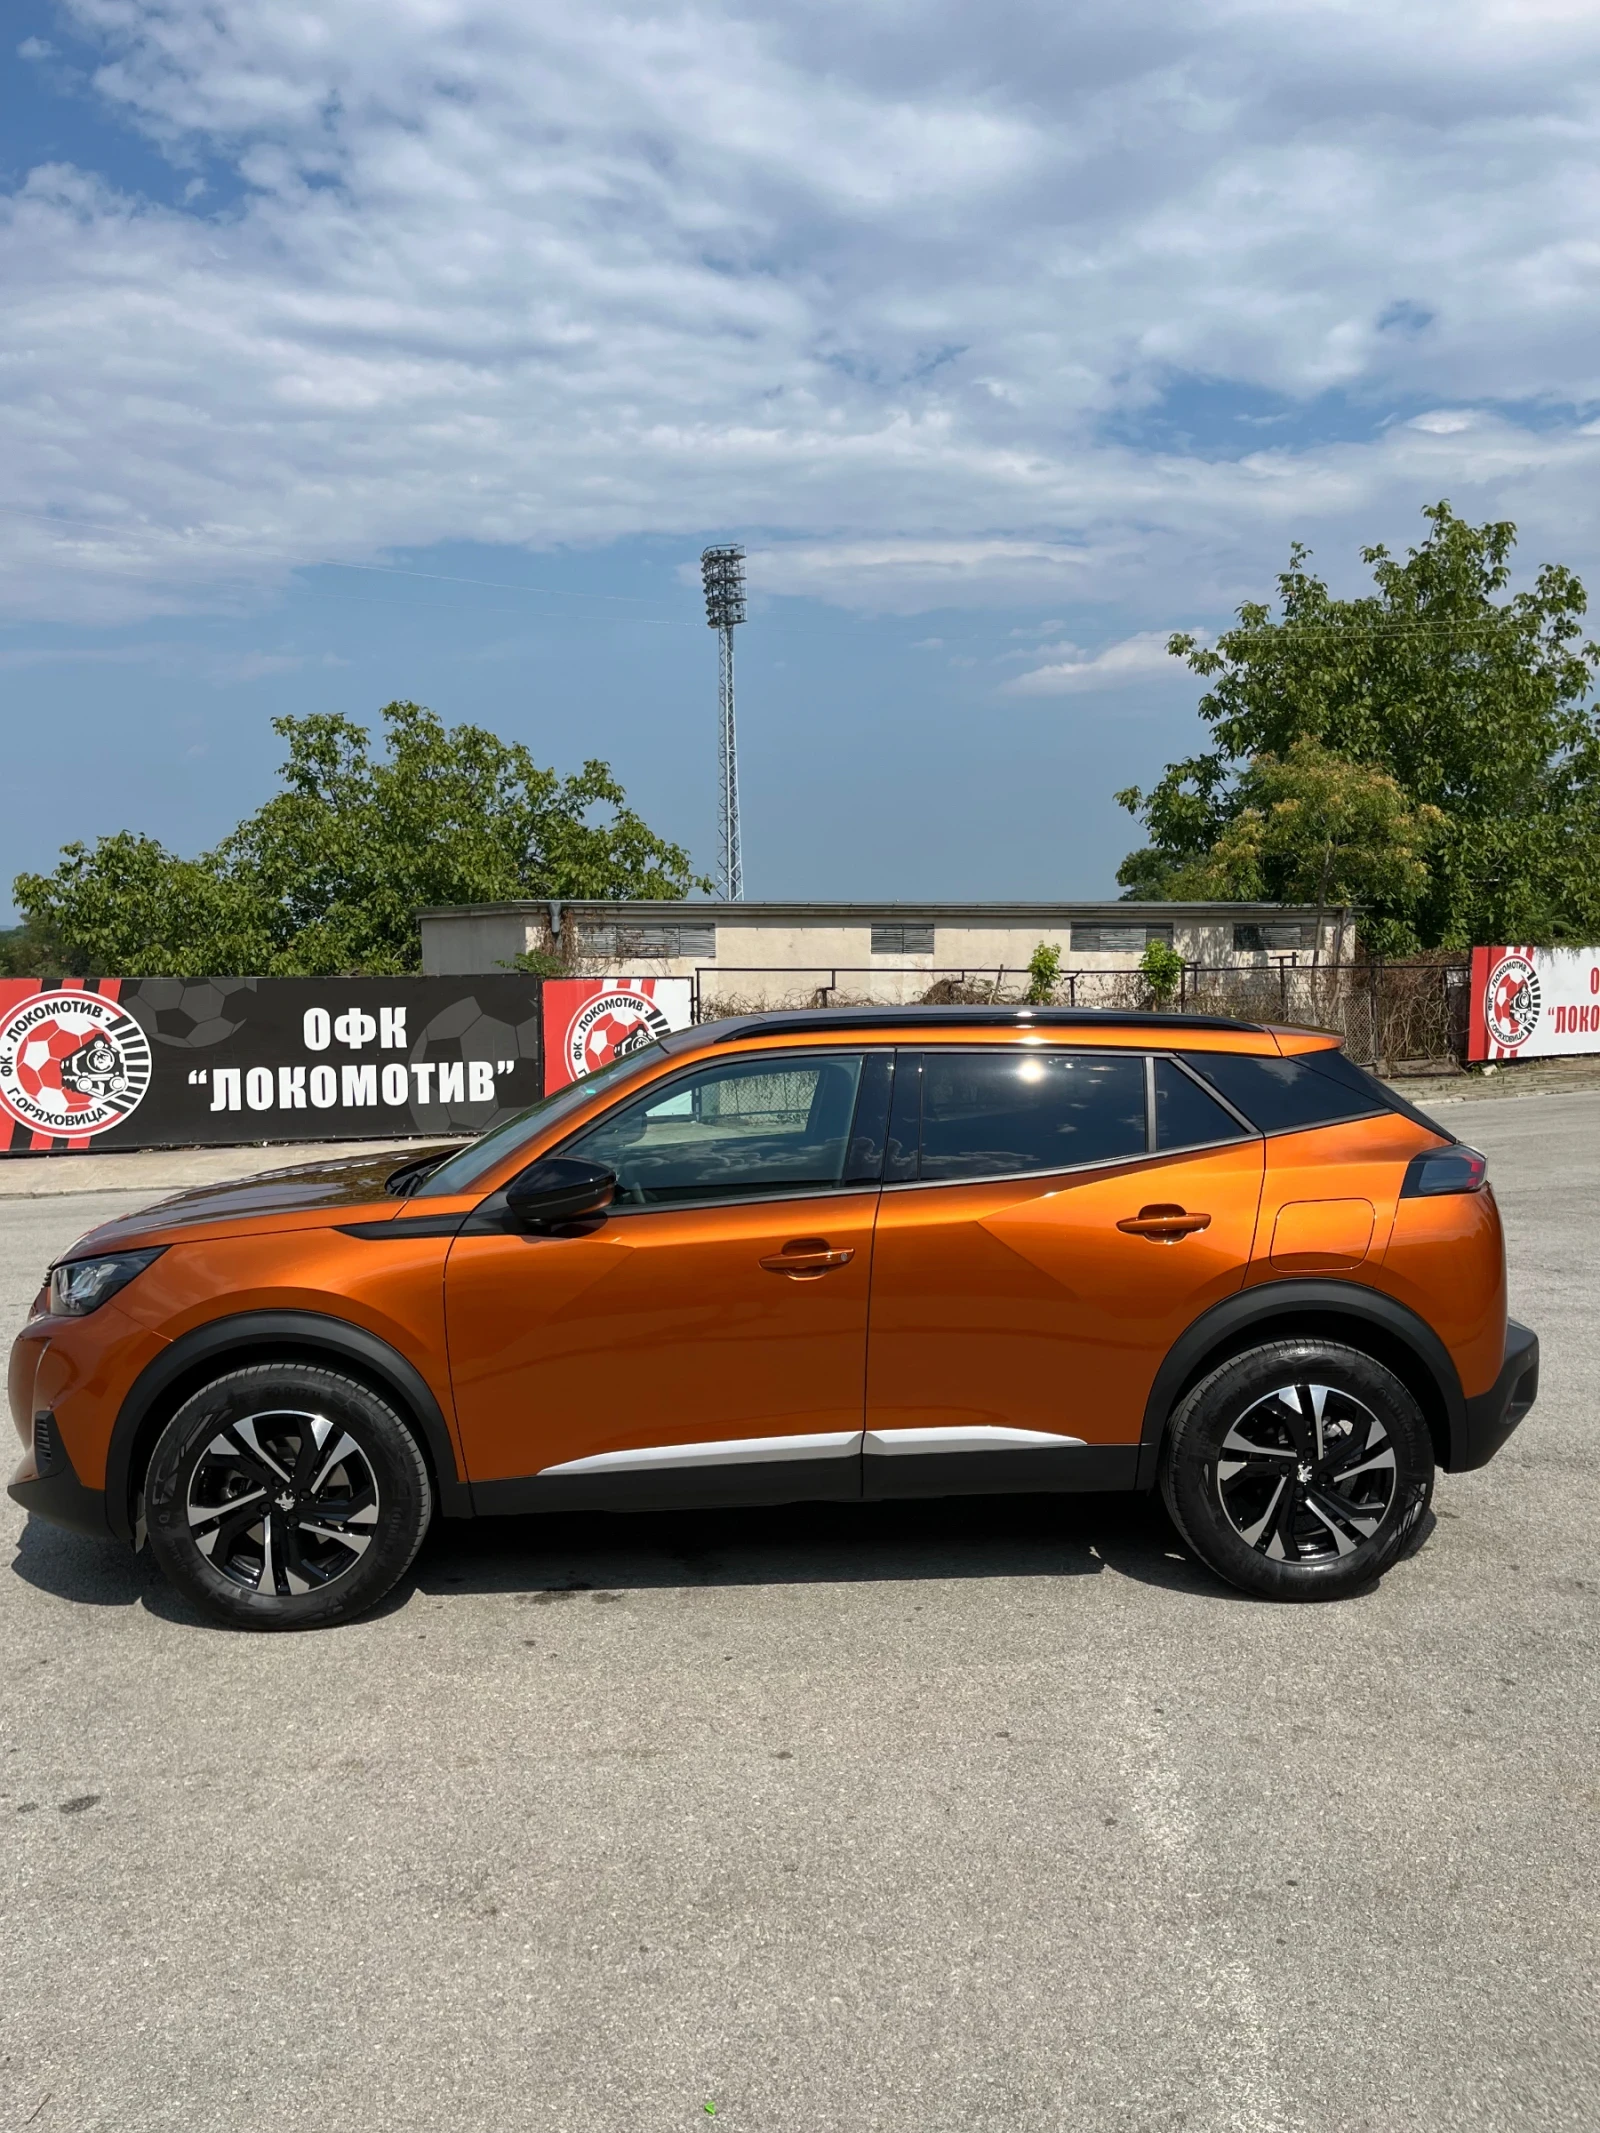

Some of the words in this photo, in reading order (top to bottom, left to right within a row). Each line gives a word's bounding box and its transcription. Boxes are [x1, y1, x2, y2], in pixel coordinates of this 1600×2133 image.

[1492, 961, 1527, 988] ЛОКОМОТИВ
[6, 1000, 103, 1043] ЛОКОМОТИВ
[303, 1006, 408, 1051] ОФК
[578, 997, 644, 1032] ЛОКОМОТИВ
[0, 1056, 13, 1077] ФК
[573, 1043, 583, 1060] ФК
[188, 1060, 515, 1112] “ЛОКОМОТИВ”
[7, 1087, 108, 1126] Г.ОРЯХОВИЦА
